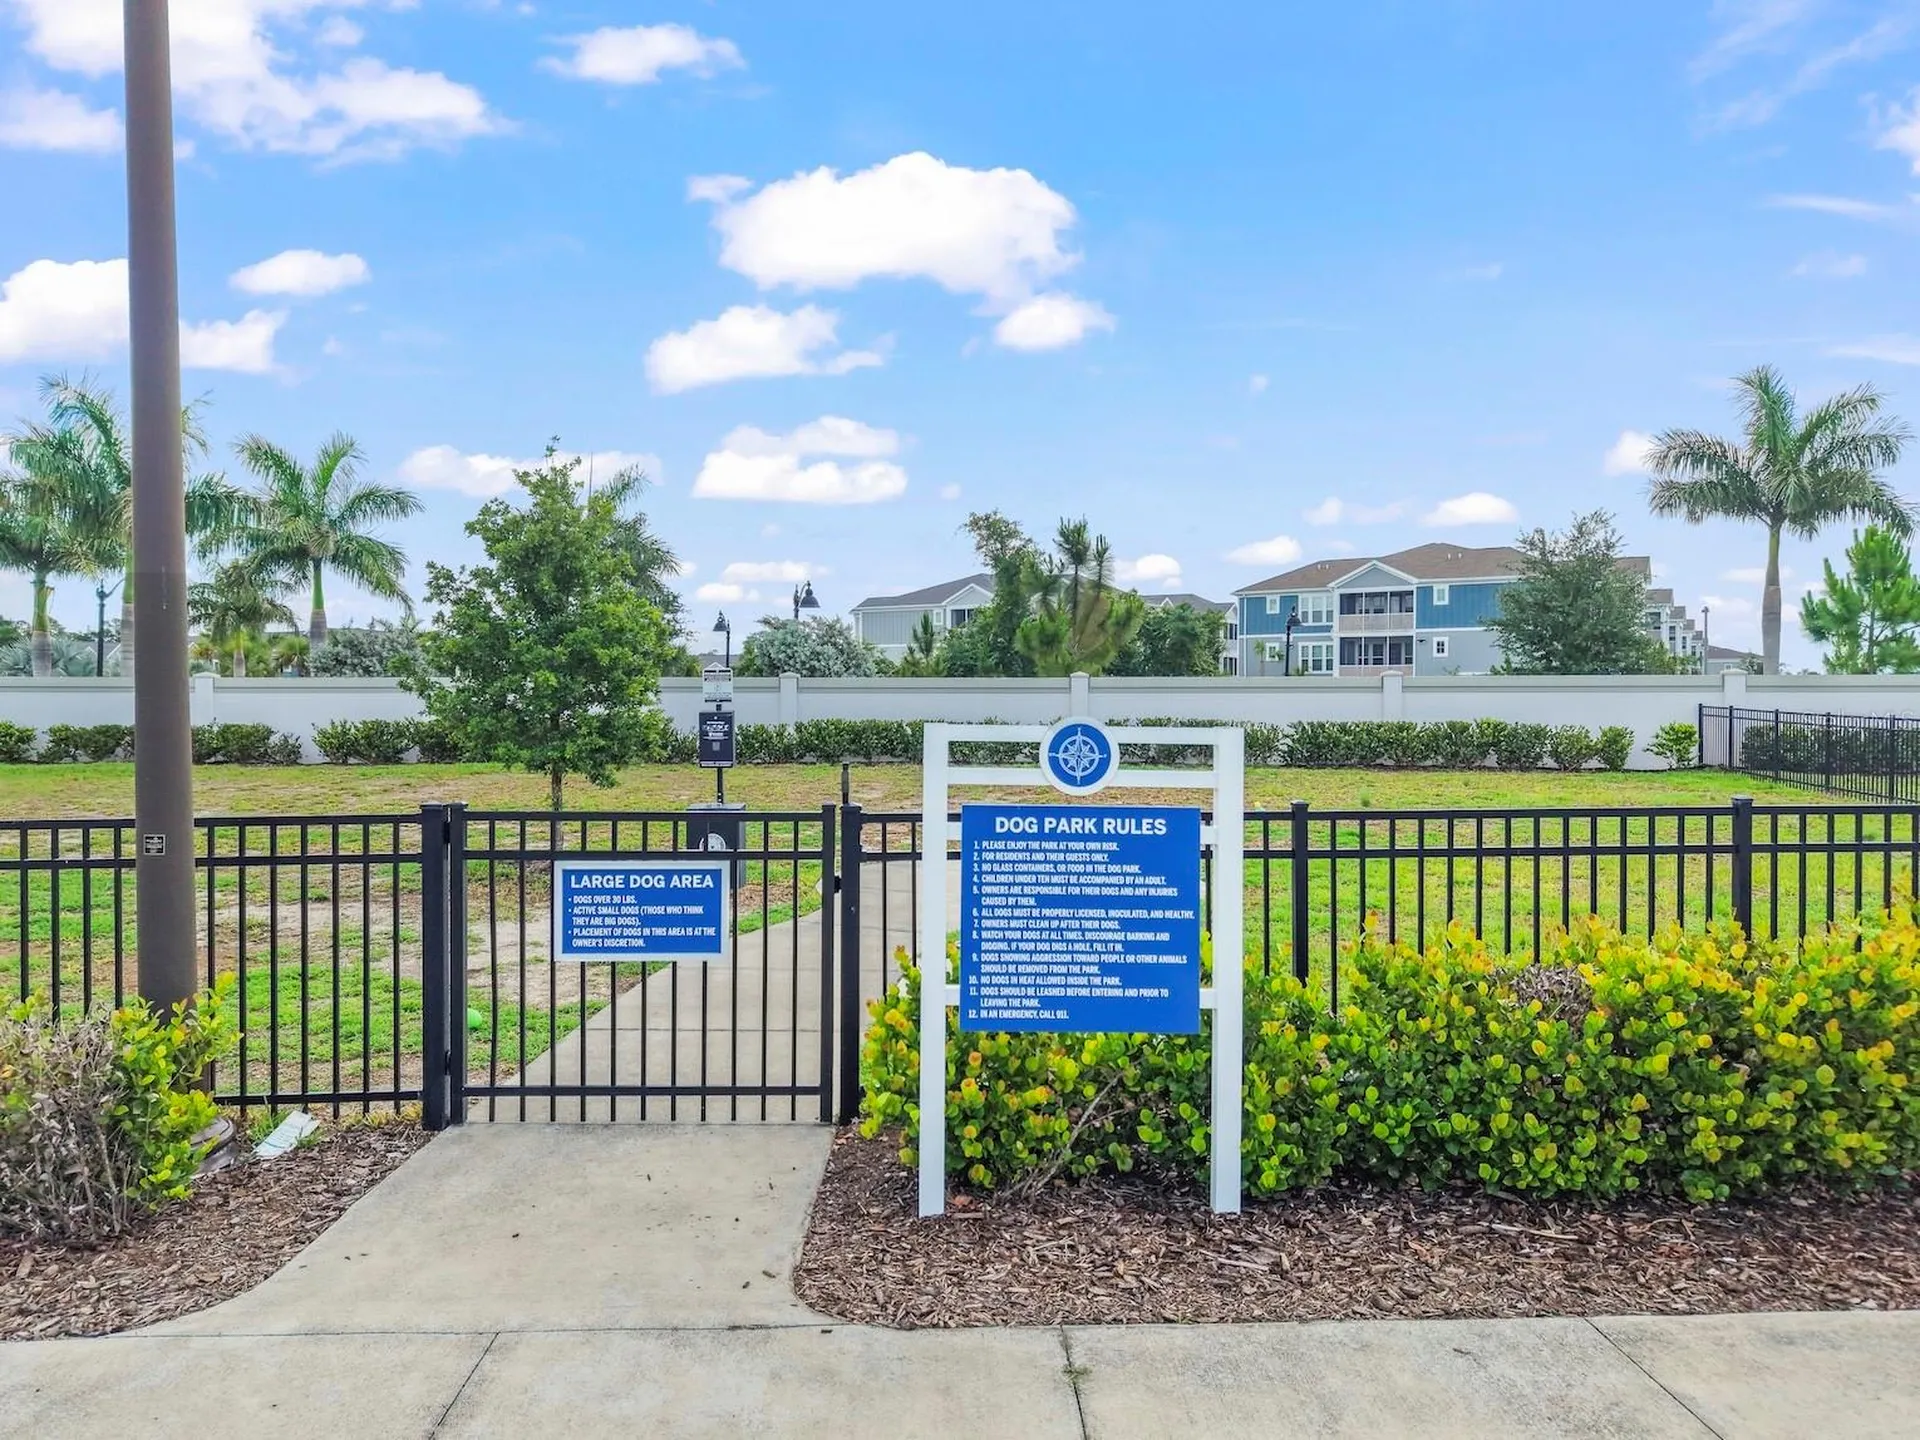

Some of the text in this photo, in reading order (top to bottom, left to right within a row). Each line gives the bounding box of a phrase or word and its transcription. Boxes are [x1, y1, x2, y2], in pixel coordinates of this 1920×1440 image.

[995, 817, 1167, 834] DOG PARK RULES
[974, 841, 1119, 850] 1. PLEASE ENJOY THE PARK AT YOUR OWN RISK.
[973, 852, 1109, 862] 2. FOR RESIDENTS AND THEIR GUESTS ONLY.
[973, 863, 980, 872] 3.
[982, 863, 991, 872] NO
[992, 863, 1013, 872] GLASS
[1057, 864, 1066, 872] OR
[1067, 864, 1085, 873] FOOD
[1085, 864, 1093, 873] IN
[1094, 864, 1107, 873] THE
[1107, 864, 1121, 873] DOG
[1123, 865, 1141, 873] PARK.
[570, 874, 714, 888] LARGE DOG AREA
[972, 874, 1166, 885] 4. CHILDREN UNDER TEN MUST BE ACCOMPANIED BY AN ADULT.
[972, 886, 1178, 896] 5. OWNERS ARE RESPONSIBLE FOR THEIR DOGS AND ANY INJURIES
[573, 895, 637, 904] DOGS OVER 30 LBS.
[982, 897, 1037, 906] CAUSED BY THEM.
[573, 906, 704, 916] ACTIVE SMALL DOGS (THOSE WHO THINK
[972, 908, 979, 916] 6.
[981, 908, 993, 916] ALL
[994, 908, 1012, 917] DOGS
[1013, 908, 1030, 917] MUST
[1032, 908, 1040, 917] BE
[1041, 909, 1074, 917] PROPERLY
[1150, 910, 1164, 918] AND
[1164, 910, 1195, 918] HEALTHY.
[572, 917, 641, 927] THEY ARE BIG DOGS).
[974, 919, 1121, 929] 7. OWNERS MUST CLEAN UP AFTER THEIR DOGS.
[573, 927, 716, 936] PLACEMENT OF DOGS IN THIS AREA IS AT THE
[972, 931, 1170, 941] 8. WATCH YOUR DOGS AT ALL TIMES. DISCOURAGE BARKING AND
[572, 938, 646, 947] OWNER'S DISCRETION.
[981, 942, 1010, 950] DIGGING.
[1011, 942, 1017, 951] IF
[1018, 942, 1035, 951] YOUR
[1036, 942, 1050, 951] DOG
[1051, 943, 1067, 951] DIGS
[1068, 943, 1073, 951] A
[1093, 943, 1107, 952] FILL
[1107, 943, 1114, 952] IT
[1114, 943, 1124, 952] IN.
[972, 953, 1187, 963] 9. DOGS SHOWING AGGRESSION TOWARD PEOPLE OR OTHER ANIMALS
[981, 964, 1100, 974] SHOULD BE REMOVED FROM THE PARK.
[969, 976, 1122, 986] 10. NO DOGS IN HEAT ALLOWED INSIDE THE PARK.
[970, 987, 1169, 997] 11. DOGS SHOULD BE LEASHED BEFORE ENTERING AND PRIOR TO
[980, 998, 1040, 1007] LEAVING THE PARK.
[969, 1010, 978, 1018] 12.
[980, 1010, 988, 1018] IN
[988, 1010, 998, 1018] AN
[1039, 1010, 1055, 1019] CALL
[1056, 1010, 1069, 1019] 911.
